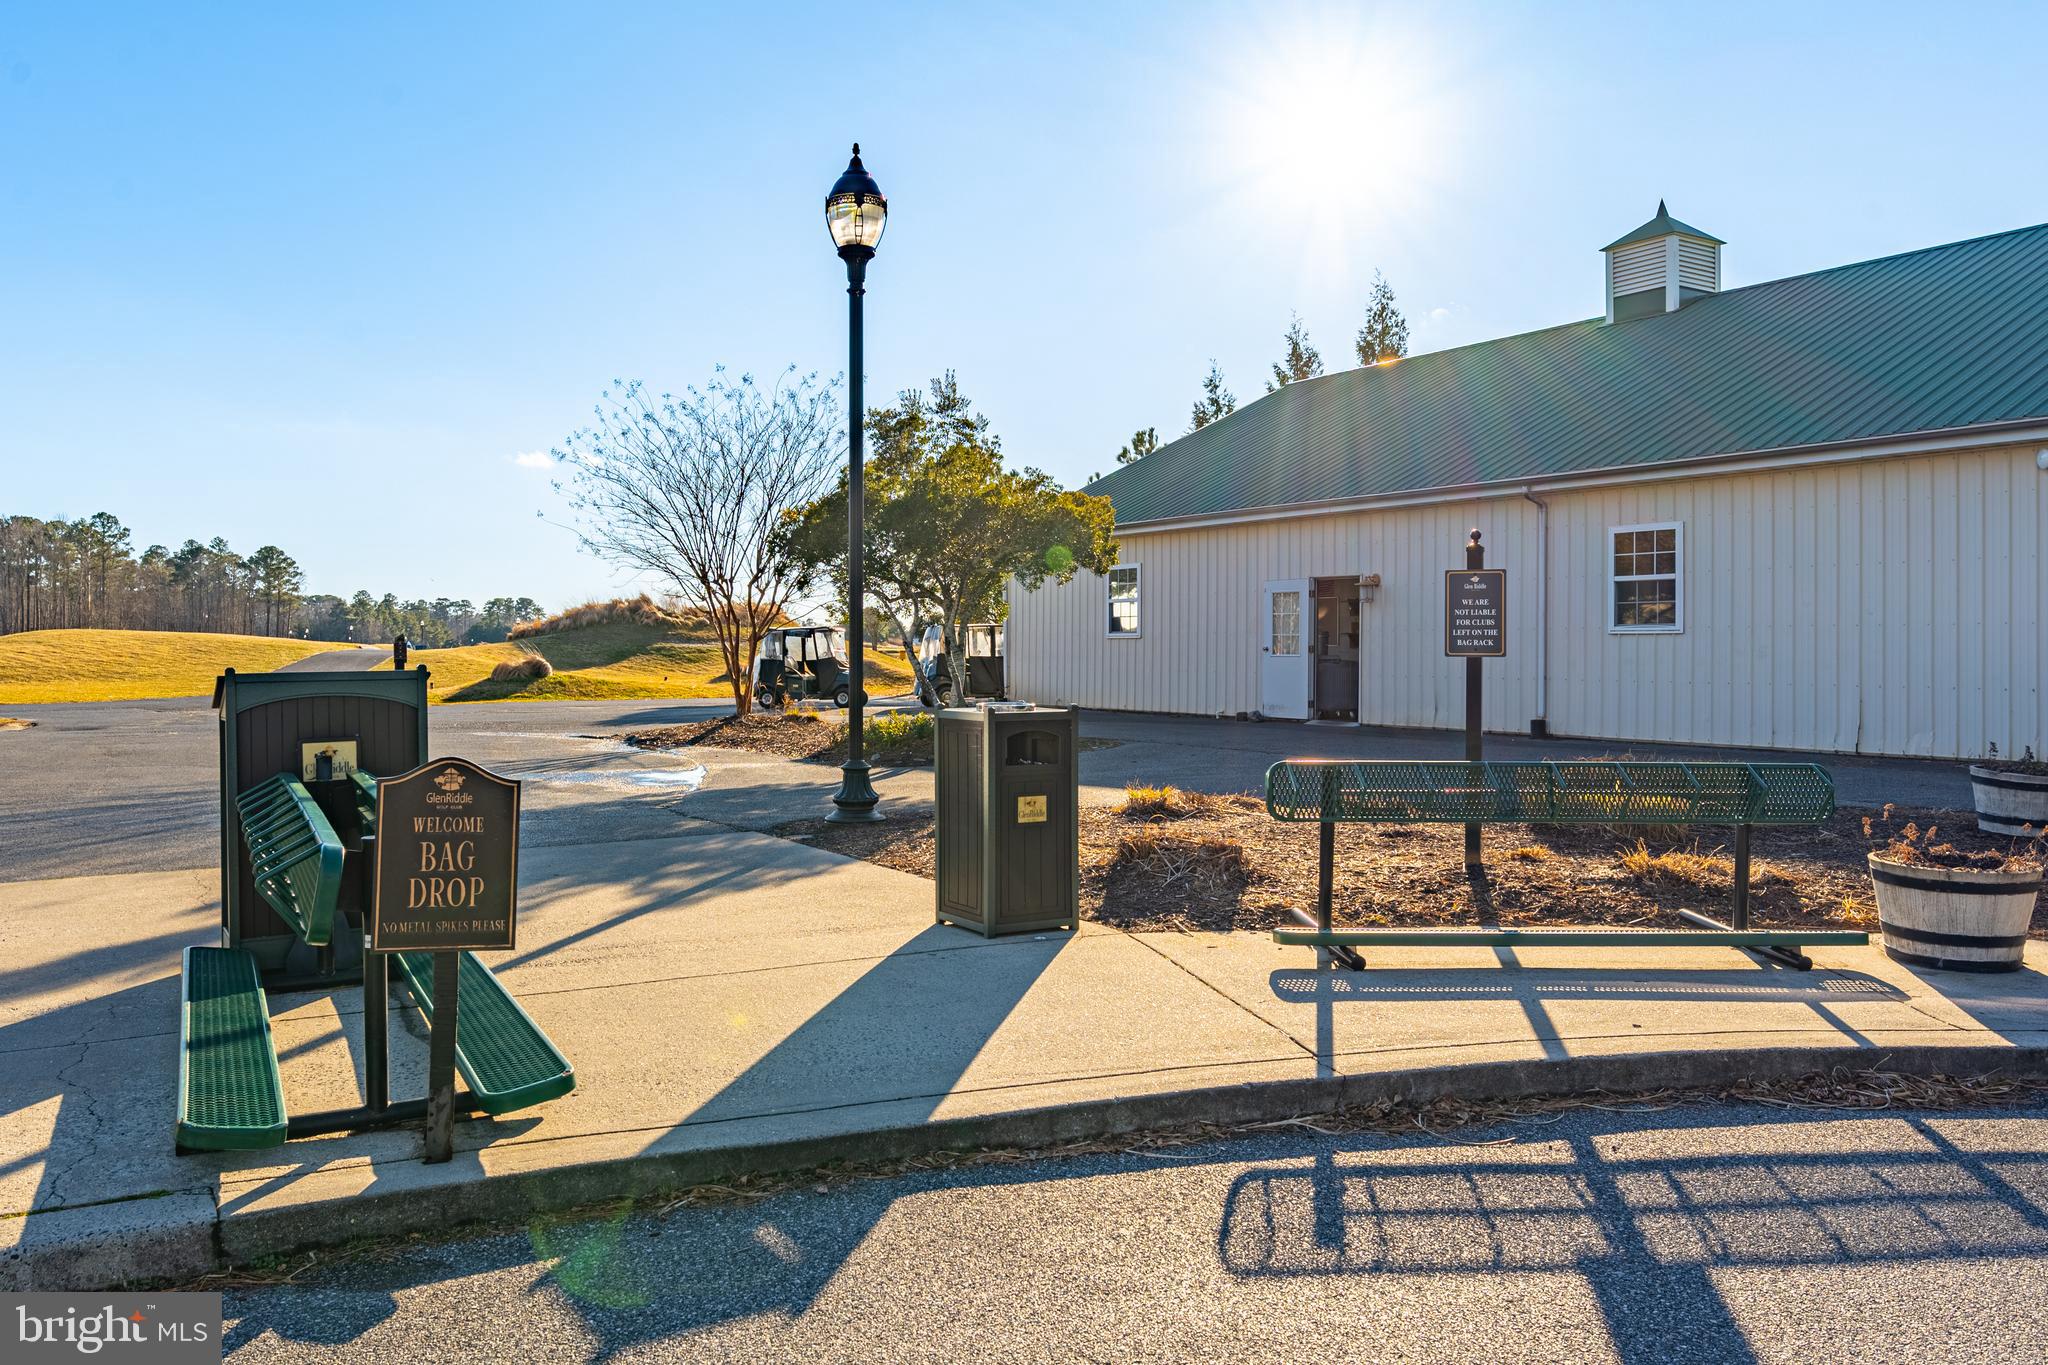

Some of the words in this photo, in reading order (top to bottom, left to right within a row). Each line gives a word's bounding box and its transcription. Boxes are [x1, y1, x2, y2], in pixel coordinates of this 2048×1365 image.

[1462, 598, 1473, 606] WE
[1475, 598, 1489, 606] ARE
[1455, 608, 1470, 616] NOT
[1471, 608, 1496, 616] LIABLE
[426, 792, 473, 804] GlenRiddle
[413, 816, 484, 833] WELCOME
[419, 840, 476, 872] BAG
[408, 876, 485, 909] DROP
[382, 922, 397, 933] NO
[399, 921, 432, 933] METAL
[435, 920, 469, 932] SPIKES
[472, 919, 506, 931] PLEASE
